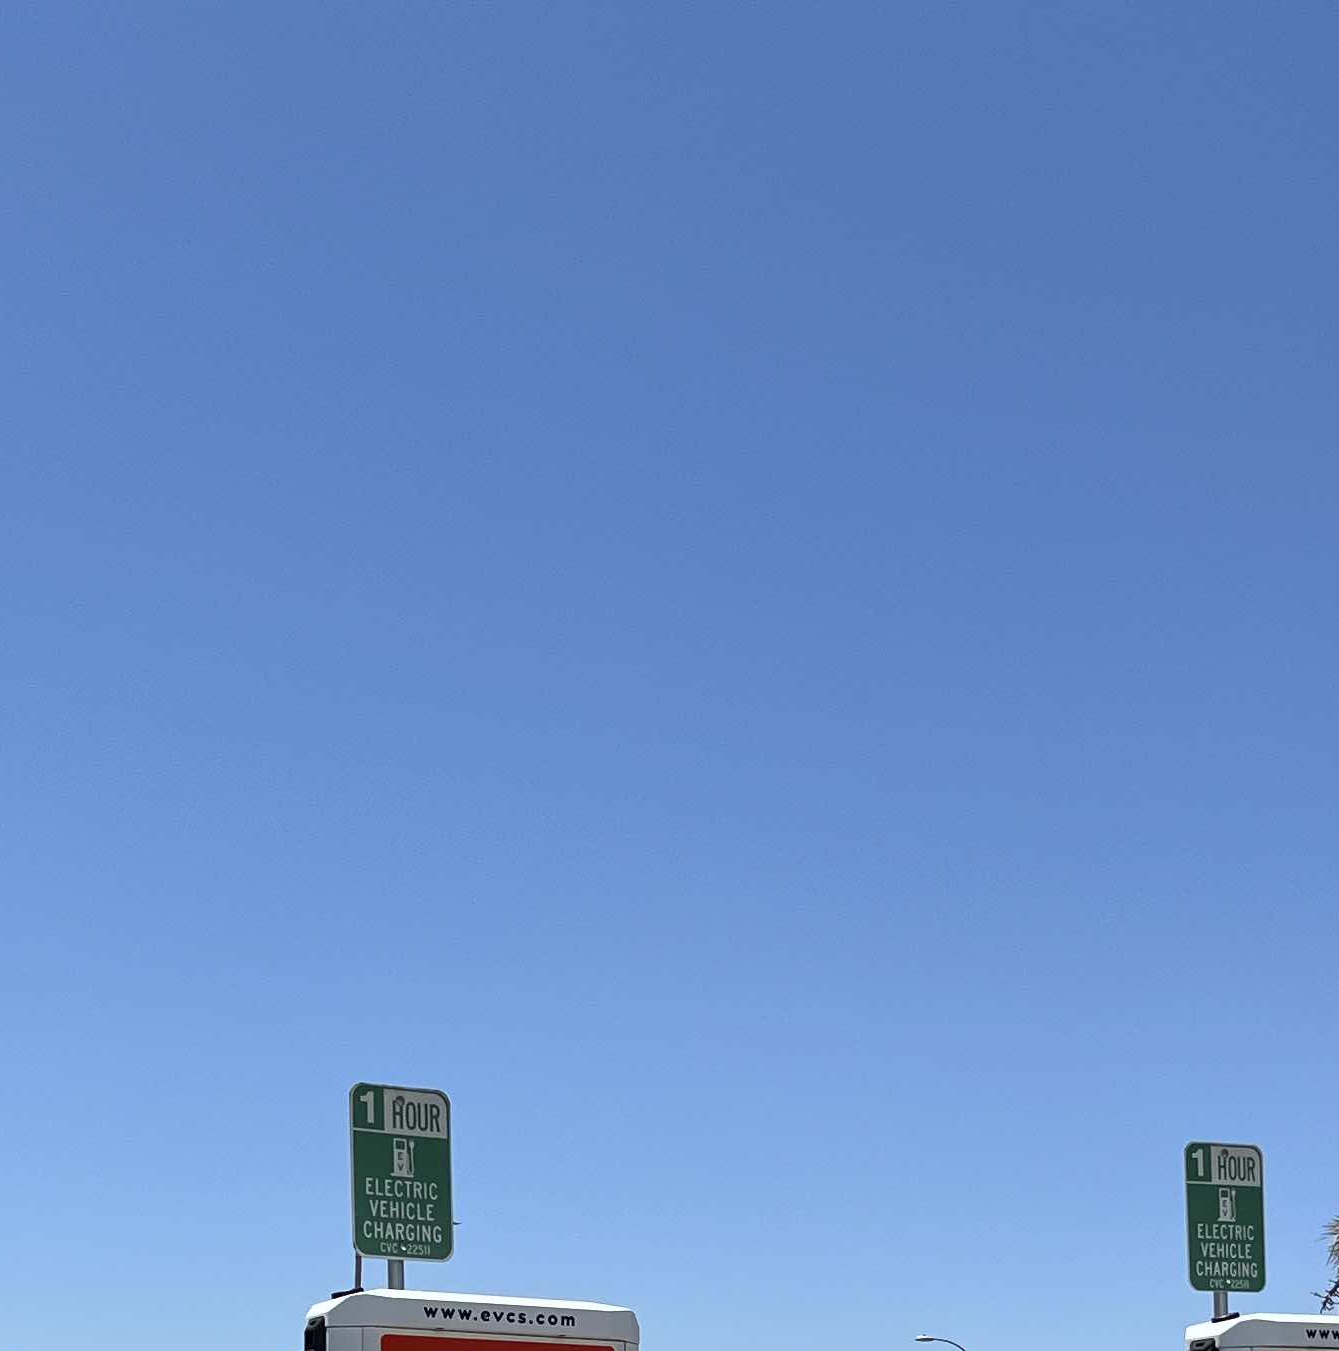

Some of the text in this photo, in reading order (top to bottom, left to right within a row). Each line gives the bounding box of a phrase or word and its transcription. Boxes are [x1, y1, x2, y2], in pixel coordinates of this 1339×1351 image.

[360, 1091, 441, 1133] 1 HOUR
[1191, 1148, 1256, 1182] 1 HOUR
[365, 1177, 438, 1201] ELECTRIC
[369, 1199, 435, 1222] VEHICLE
[363, 1220, 443, 1244] CHARGING
[1197, 1223, 1255, 1241] ELECTRIC
[1200, 1242, 1252, 1259] VEHICLE
[1196, 1261, 1258, 1278] CHARGING
[423, 1306, 576, 1327] www.evcs.com
